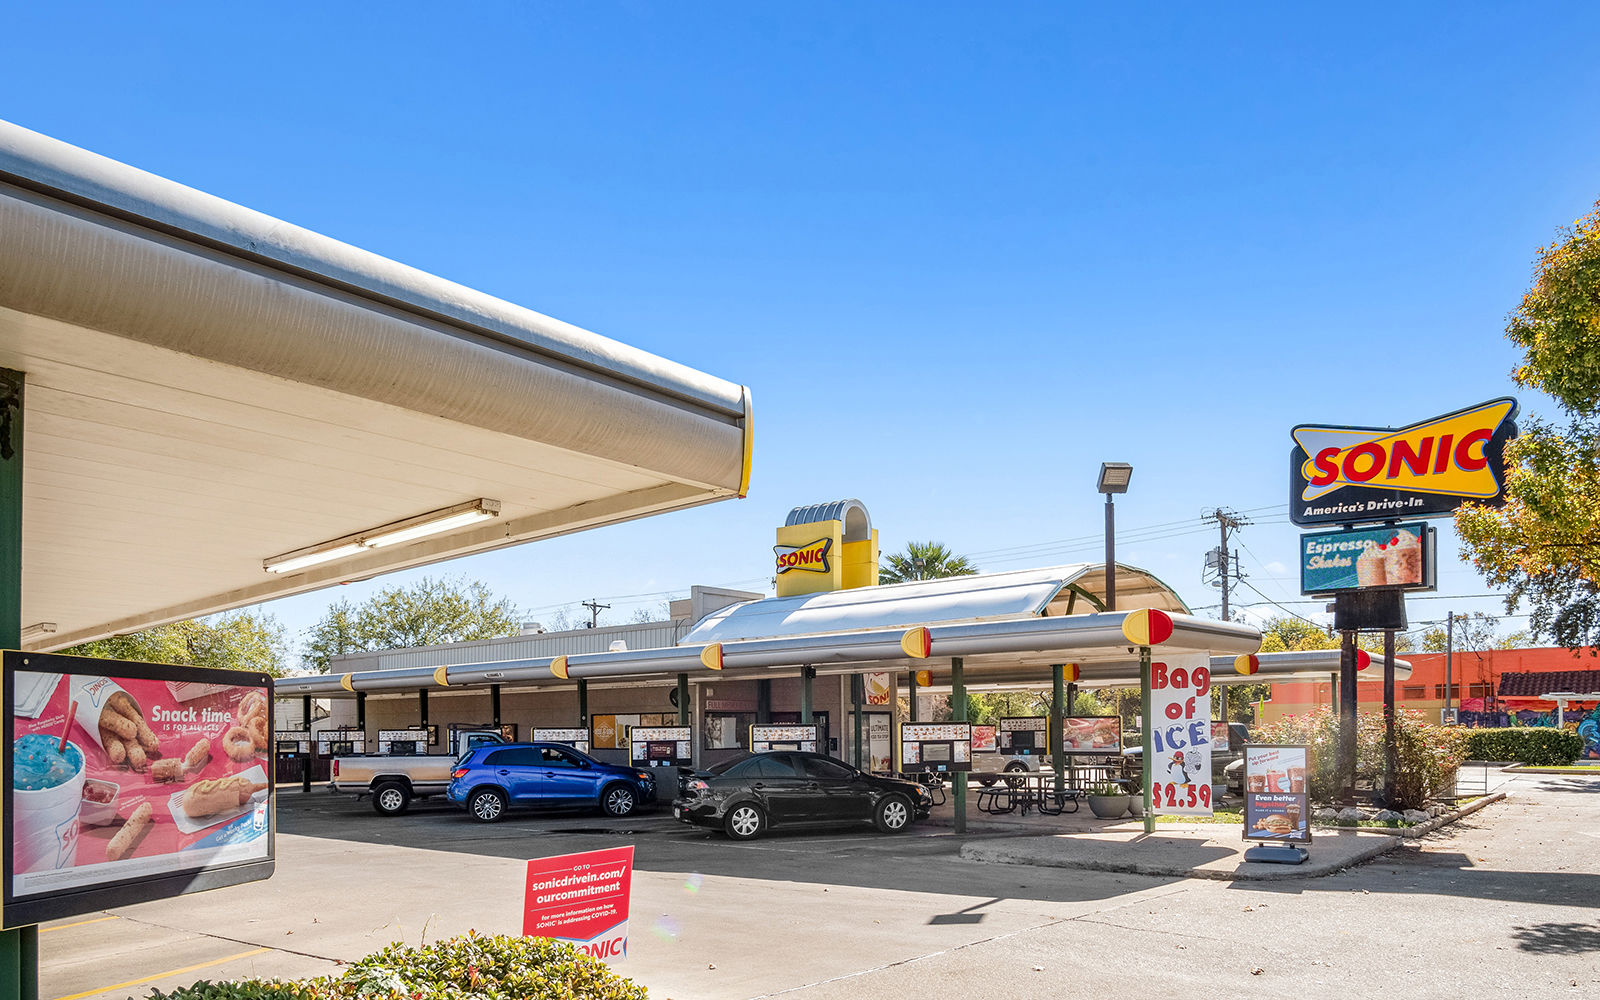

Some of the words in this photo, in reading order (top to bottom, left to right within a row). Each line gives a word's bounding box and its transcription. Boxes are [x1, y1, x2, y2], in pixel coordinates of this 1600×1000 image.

[1308, 428, 1494, 487] SONIC
[1303, 502, 1364, 517] America's
[1306, 539, 1373, 554] Espresso
[778, 547, 824, 568] SONIC
[1306, 553, 1352, 570] Shakes
[1151, 661, 1210, 697] Bag
[868, 690, 889, 705] SONI
[1165, 696, 1196, 720] of
[151, 705, 197, 722] Snack
[201, 707, 232, 723] time
[1151, 719, 1209, 753] ICE
[1152, 782, 1211, 809] $2.59
[532, 866, 626, 891] sonicdrivein.com/
[536, 881, 621, 904] ourcommitment
[563, 915, 591, 924] addressing
[566, 907, 596, 917] information
